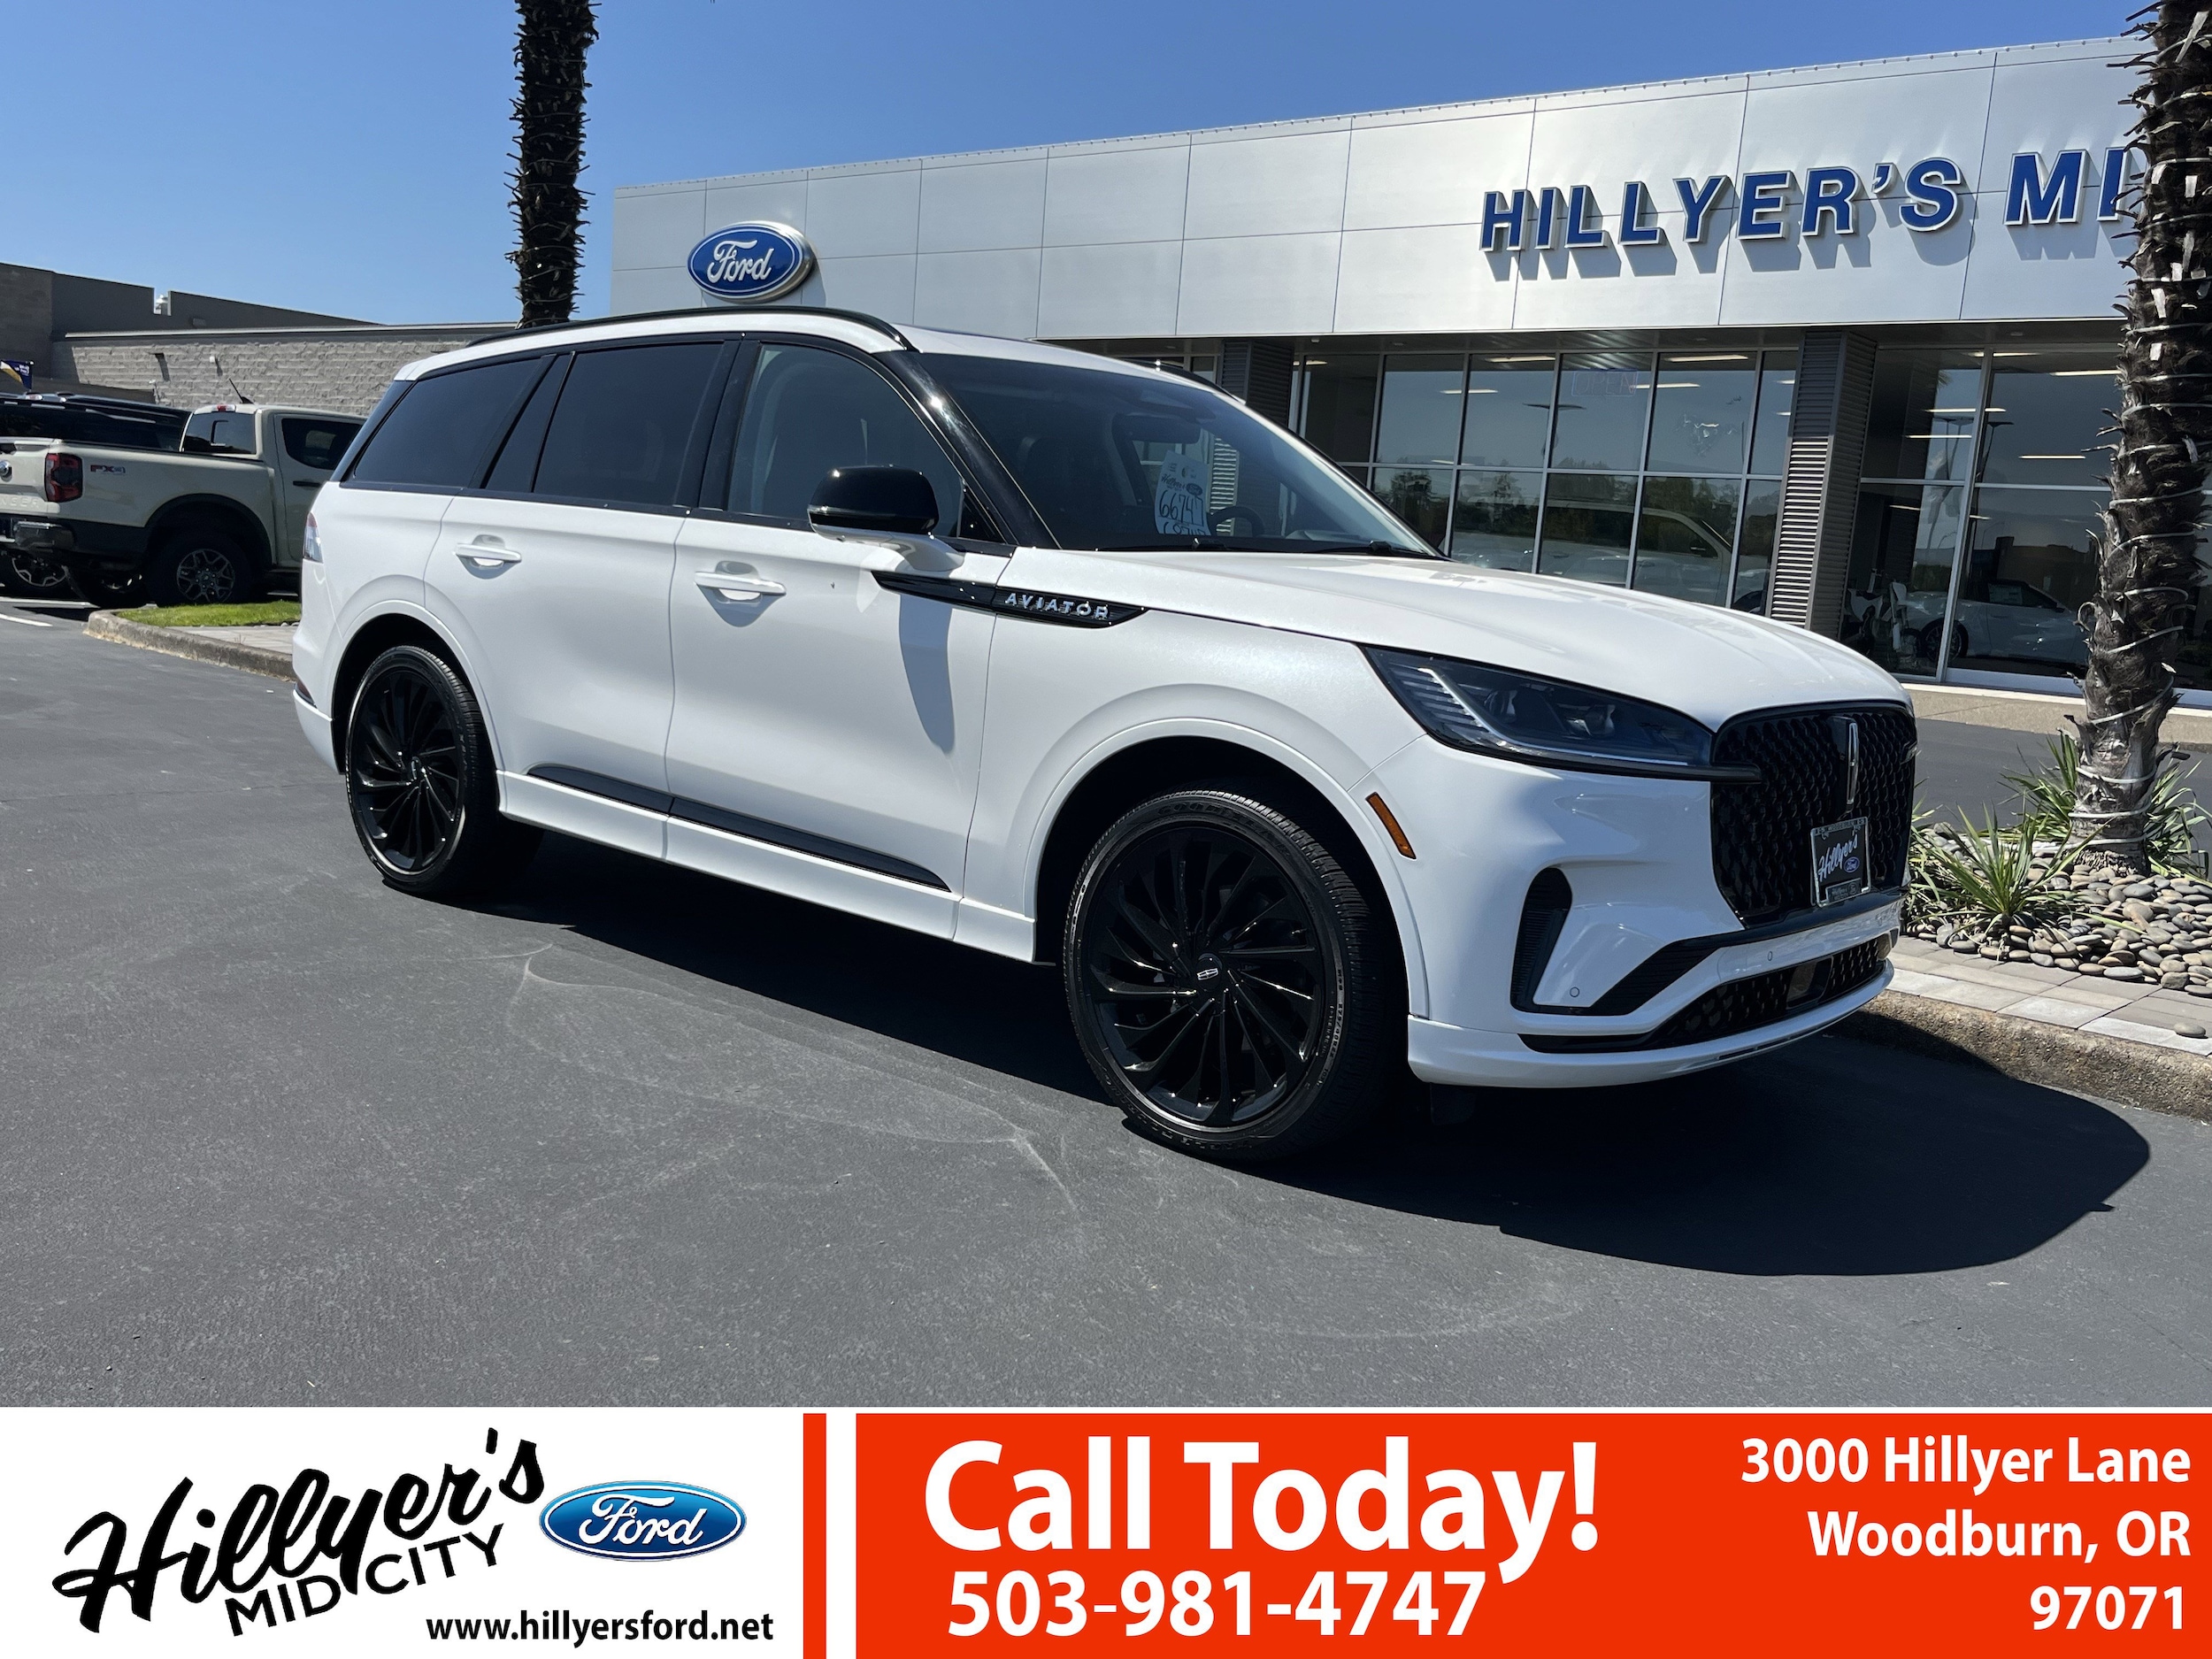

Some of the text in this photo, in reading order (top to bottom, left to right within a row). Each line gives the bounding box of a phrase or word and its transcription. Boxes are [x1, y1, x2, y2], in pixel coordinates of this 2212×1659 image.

[1479, 157, 1962, 253] HILLYER'S
[707, 240, 774, 283] Ford
[1575, 372, 1635, 395] OPEN
[1005, 593, 1109, 620] AVIATOR
